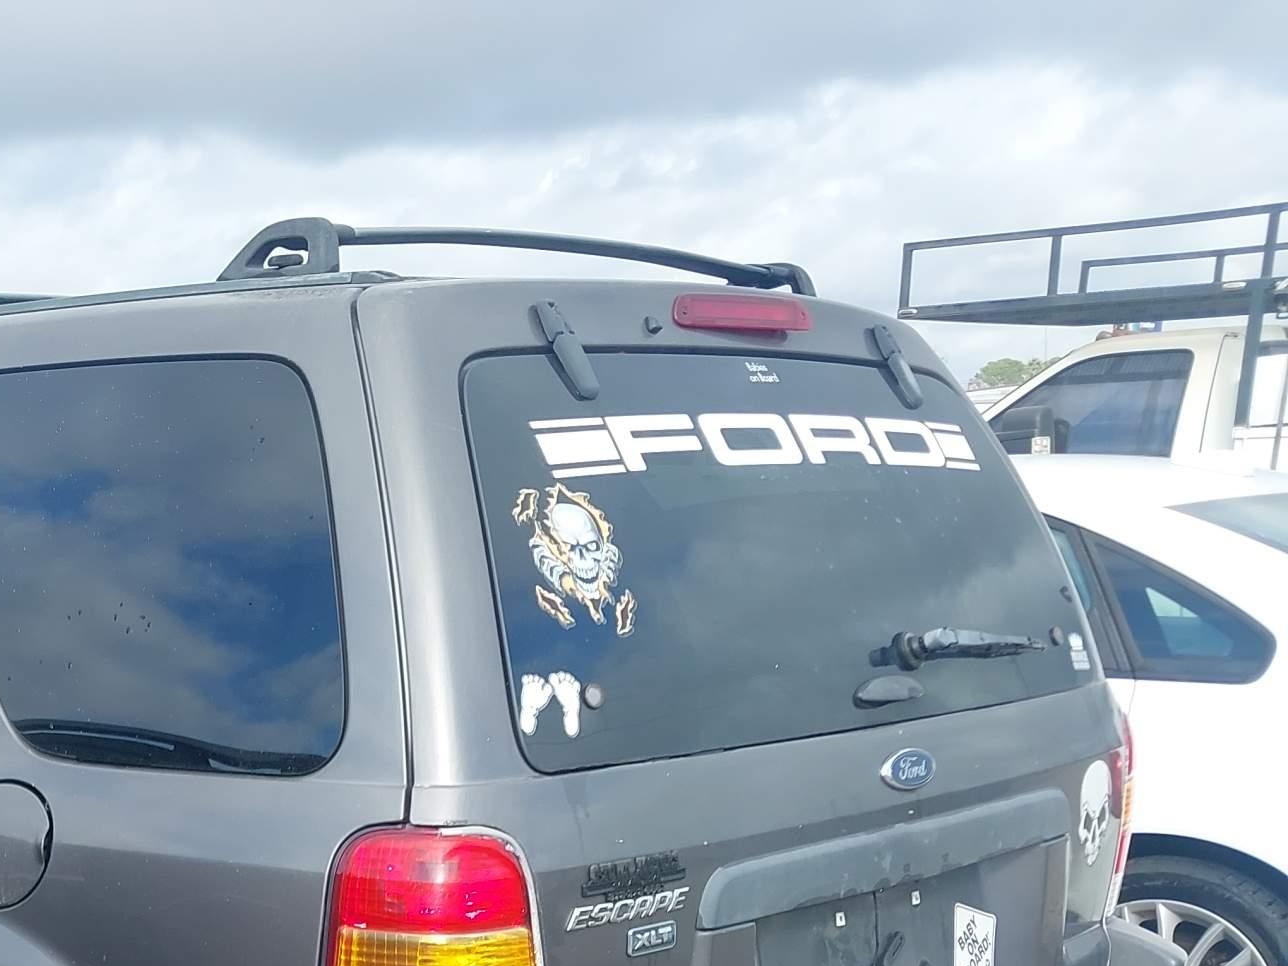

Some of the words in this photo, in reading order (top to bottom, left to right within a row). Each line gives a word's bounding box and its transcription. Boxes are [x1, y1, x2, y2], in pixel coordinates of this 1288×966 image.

[604, 414, 947, 471] FORD
[898, 756, 928, 780] Ford
[566, 886, 690, 932] ESCAPE
[633, 926, 673, 951] XLT
[958, 914, 977, 951] BABY
[968, 932, 979, 956] ON
